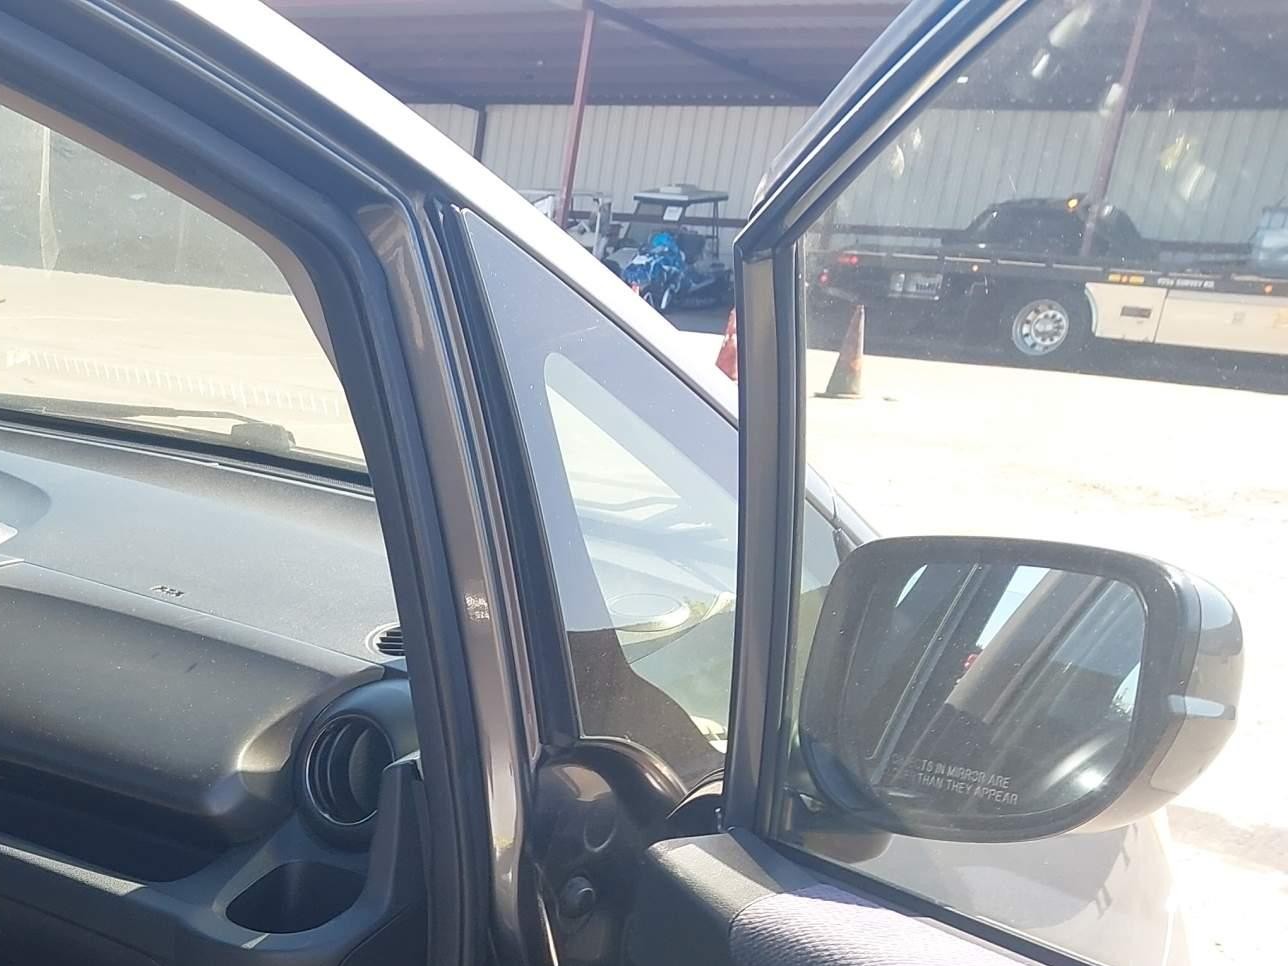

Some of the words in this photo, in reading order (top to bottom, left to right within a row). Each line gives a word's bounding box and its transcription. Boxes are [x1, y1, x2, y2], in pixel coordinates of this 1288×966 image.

[917, 772, 945, 789] THAN
[946, 778, 973, 795] THEY
[973, 786, 1019, 806] APPEAR
[935, 762, 945, 774] IN
[946, 765, 986, 783] MIRROR
[987, 774, 1012, 789] ARE
